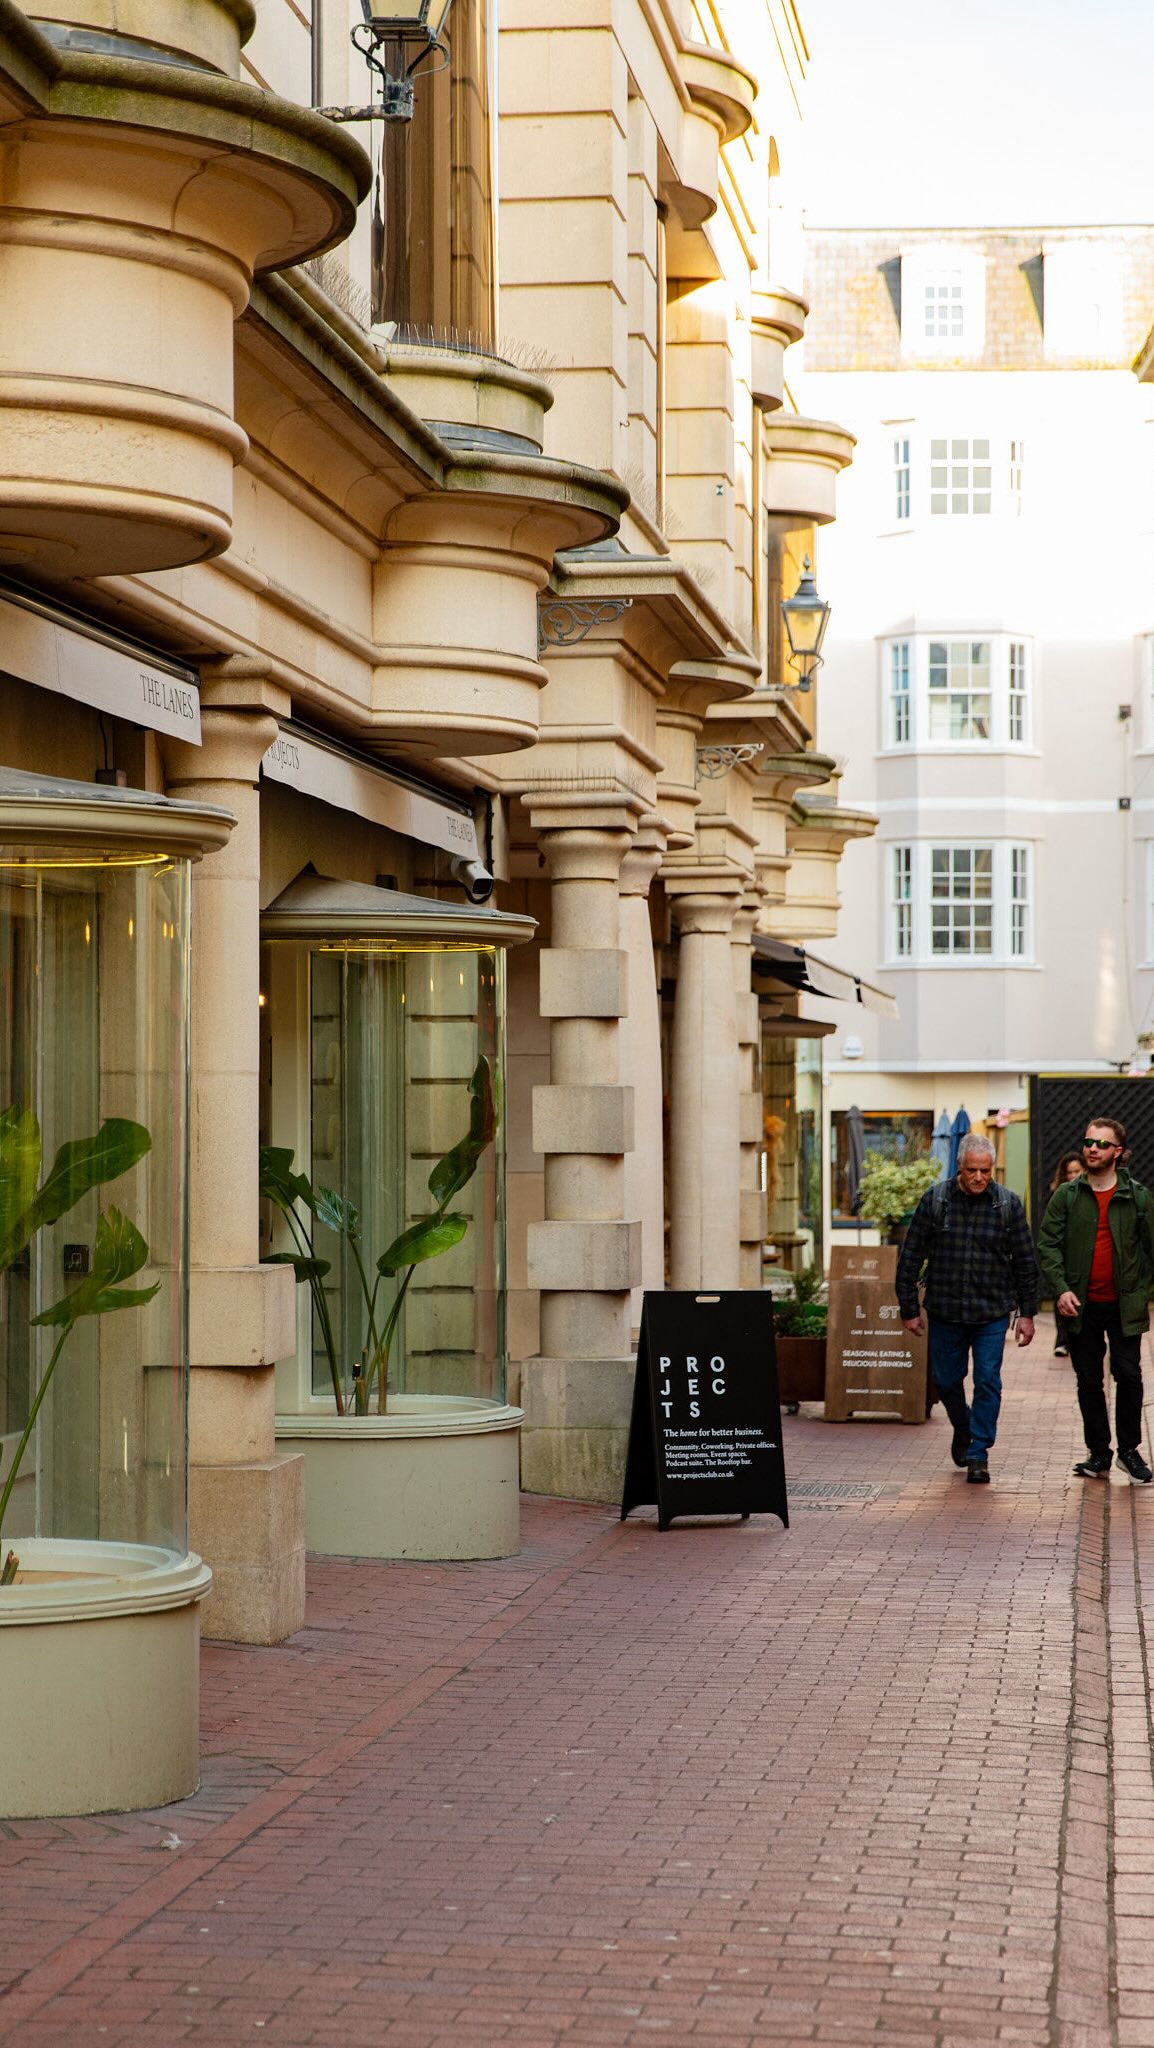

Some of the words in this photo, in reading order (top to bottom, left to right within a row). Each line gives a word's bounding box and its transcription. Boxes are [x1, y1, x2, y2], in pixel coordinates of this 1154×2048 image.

[140, 674, 161, 707] THE
[162, 683, 194, 719] LANES
[664, 1429, 679, 1437] The
[680, 1429, 698, 1437] home
[699, 1428, 710, 1437] for
[711, 1428, 734, 1436] better
[735, 1428, 764, 1436] business.
[664, 1443, 701, 1451] Community.
[756, 1441, 777, 1449] offices.
[665, 1452, 689, 1460] Meeting
[717, 1459, 740, 1467] Rooftop
[666, 1470, 735, 1480] www.projectsclub.co.uk
